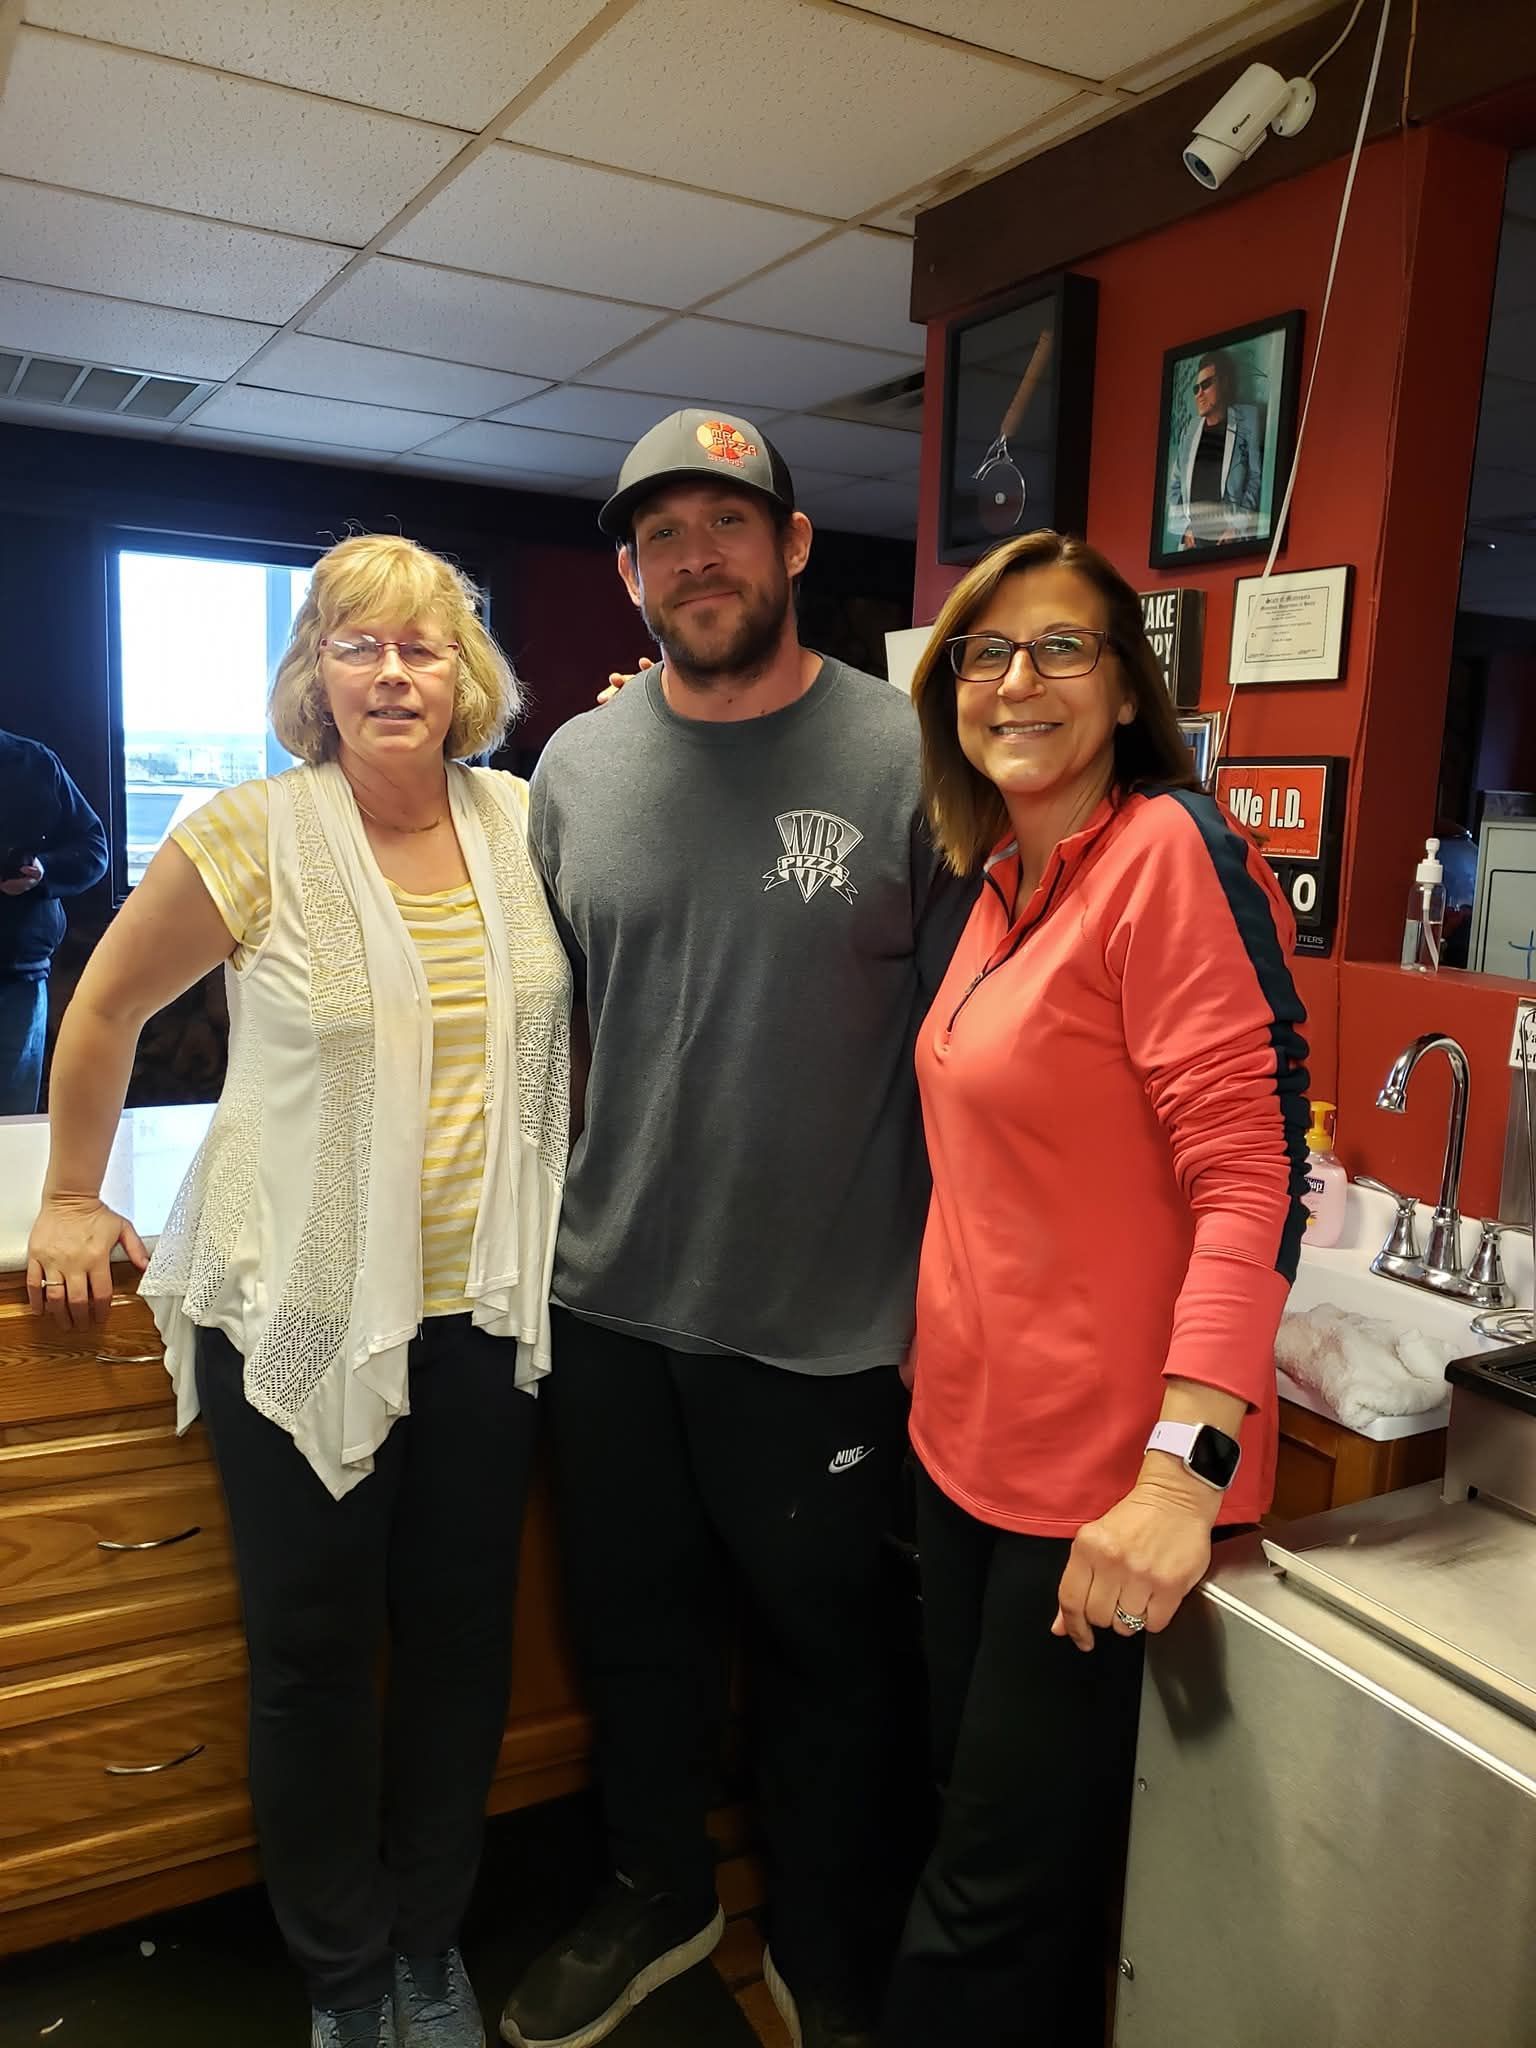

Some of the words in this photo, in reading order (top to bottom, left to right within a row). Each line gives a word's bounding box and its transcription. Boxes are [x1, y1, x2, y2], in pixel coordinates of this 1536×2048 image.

[713, 437, 758, 457] PIZZA
[1141, 594, 1176, 629] AKE
[1229, 788, 1264, 827] We
[1269, 788, 1305, 828] I.D.
[781, 856, 844, 881] PIZZA
[1296, 934, 1324, 944] TTERS
[834, 1445, 865, 1465] NIKE
